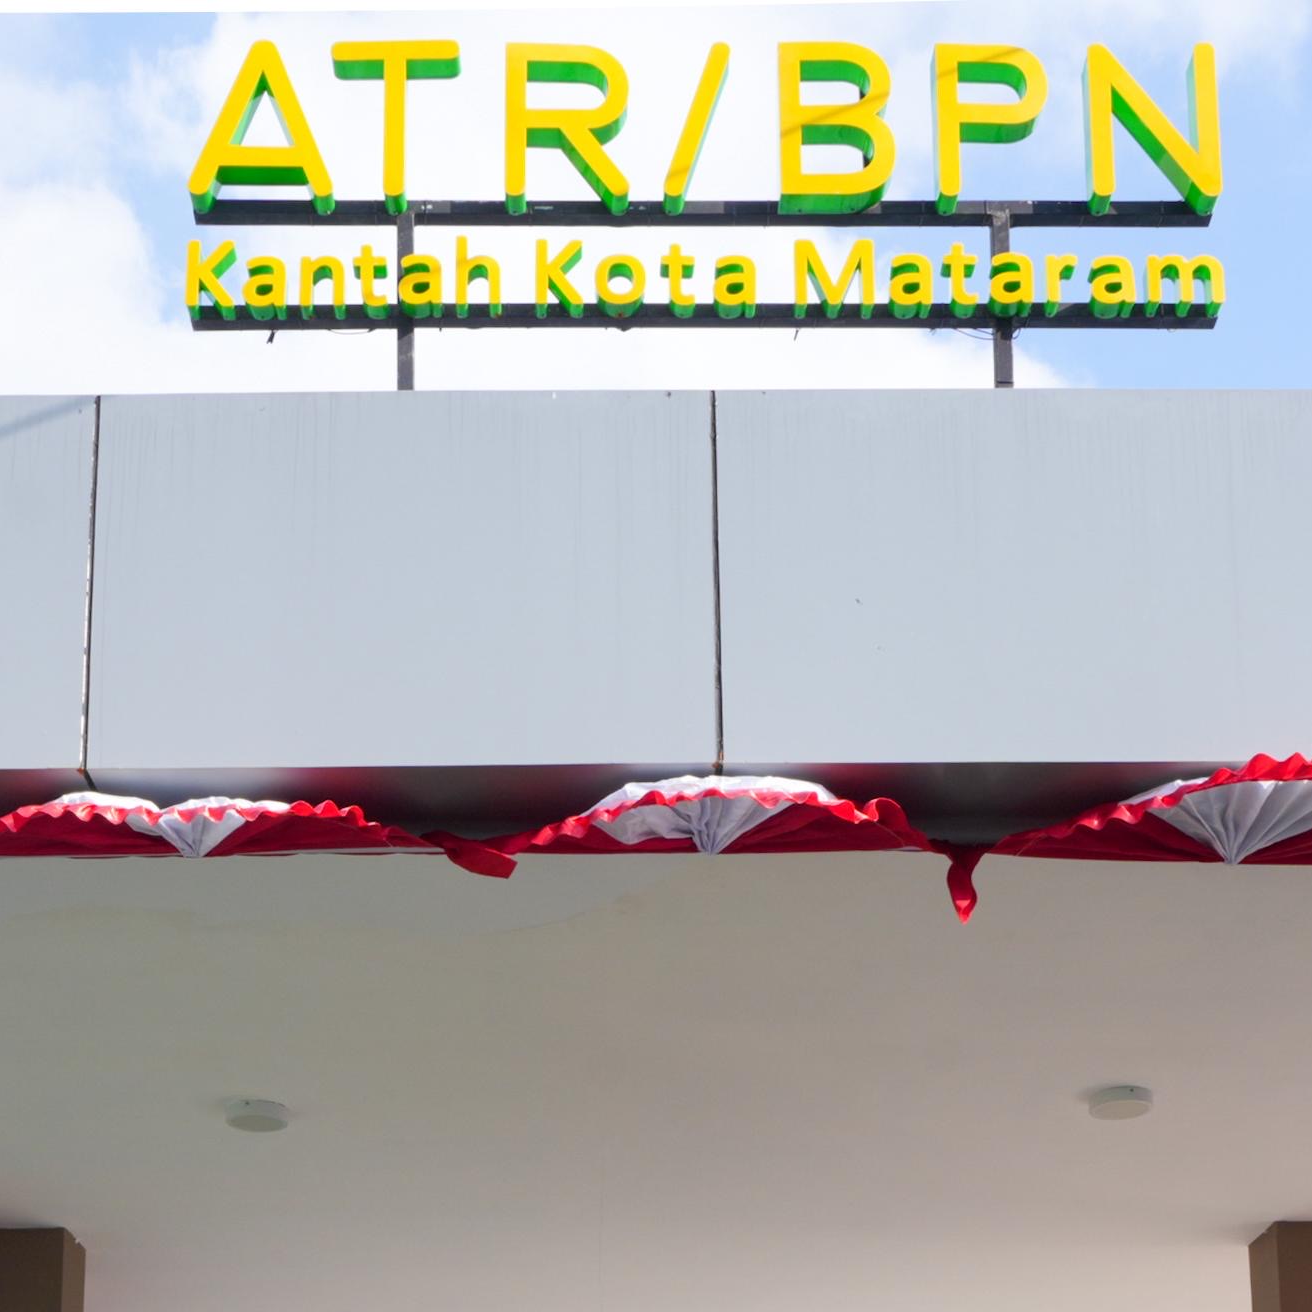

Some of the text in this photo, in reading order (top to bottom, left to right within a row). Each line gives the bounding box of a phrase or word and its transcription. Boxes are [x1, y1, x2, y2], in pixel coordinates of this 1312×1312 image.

[187, 39, 1224, 214] ATR/BPN
[185, 236, 1226, 318] Kantah Kota Mataram
